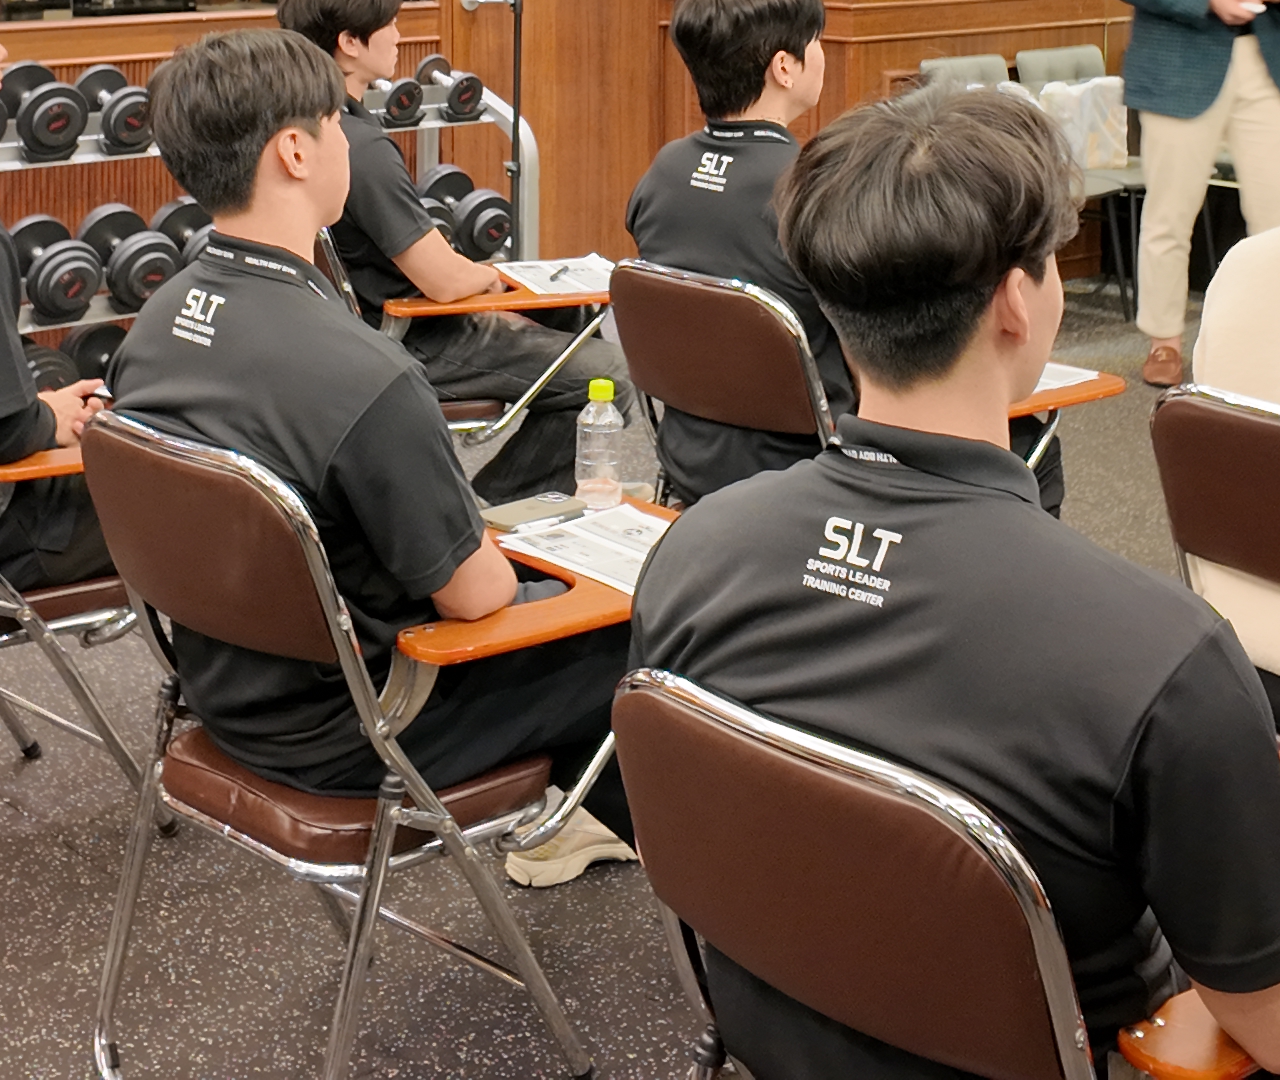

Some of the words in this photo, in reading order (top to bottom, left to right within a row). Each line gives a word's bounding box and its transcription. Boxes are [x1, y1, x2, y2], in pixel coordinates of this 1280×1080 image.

[697, 152, 734, 176] SLT
[181, 288, 226, 324] SLT
[819, 516, 903, 572] SLT
[803, 574, 847, 597] TRAINING
[848, 587, 884, 608] CENTER
[806, 558, 848, 580] SPORTS
[848, 570, 891, 591] LEADER
